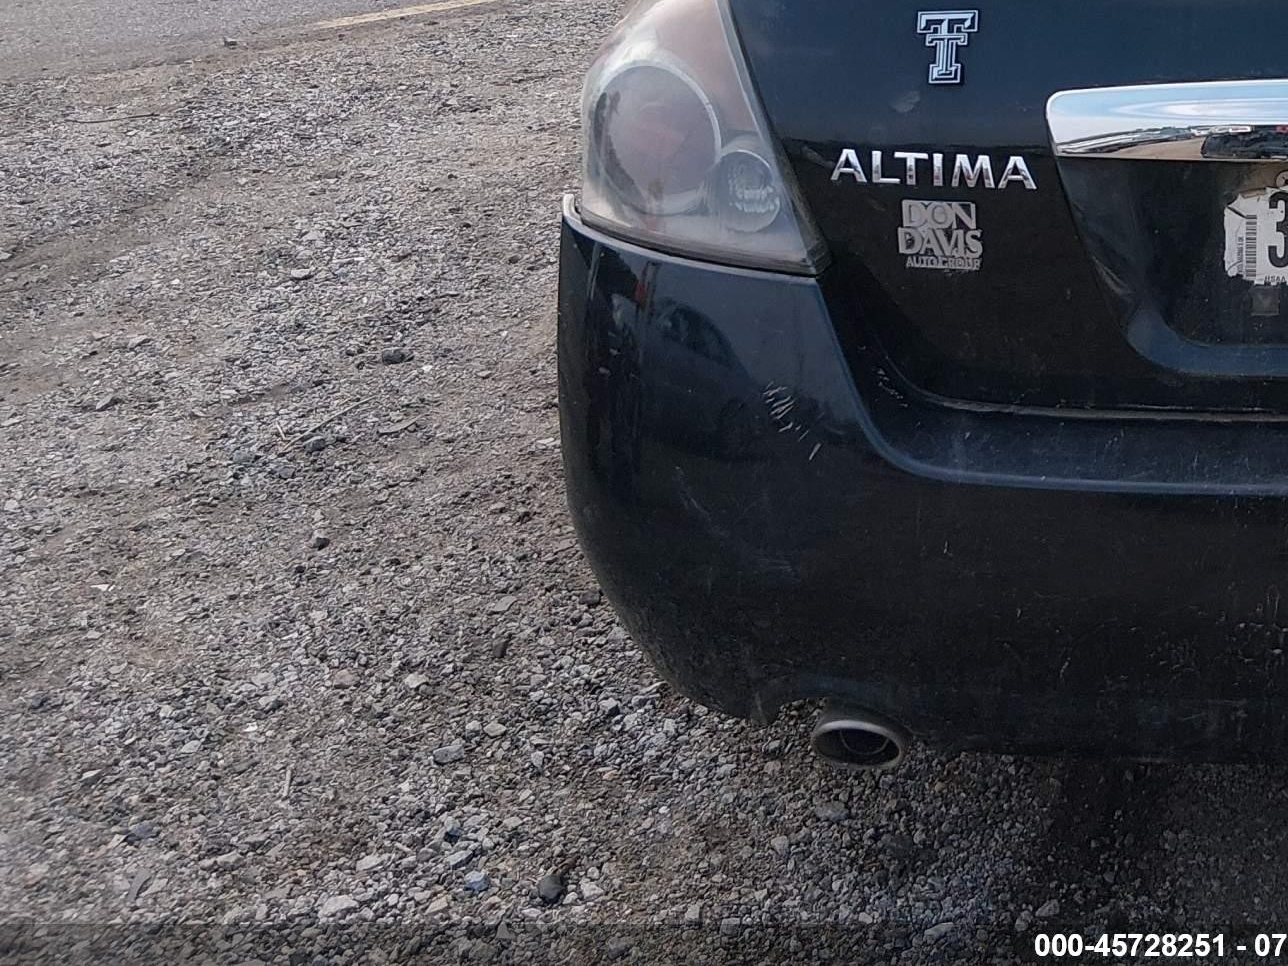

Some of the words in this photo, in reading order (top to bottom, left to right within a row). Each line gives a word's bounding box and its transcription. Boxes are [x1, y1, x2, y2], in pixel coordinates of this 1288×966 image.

[830, 148, 1038, 190] ALTIMA
[902, 199, 977, 230] DON
[897, 226, 983, 259] DAVIS
[905, 255, 938, 268] AUTO
